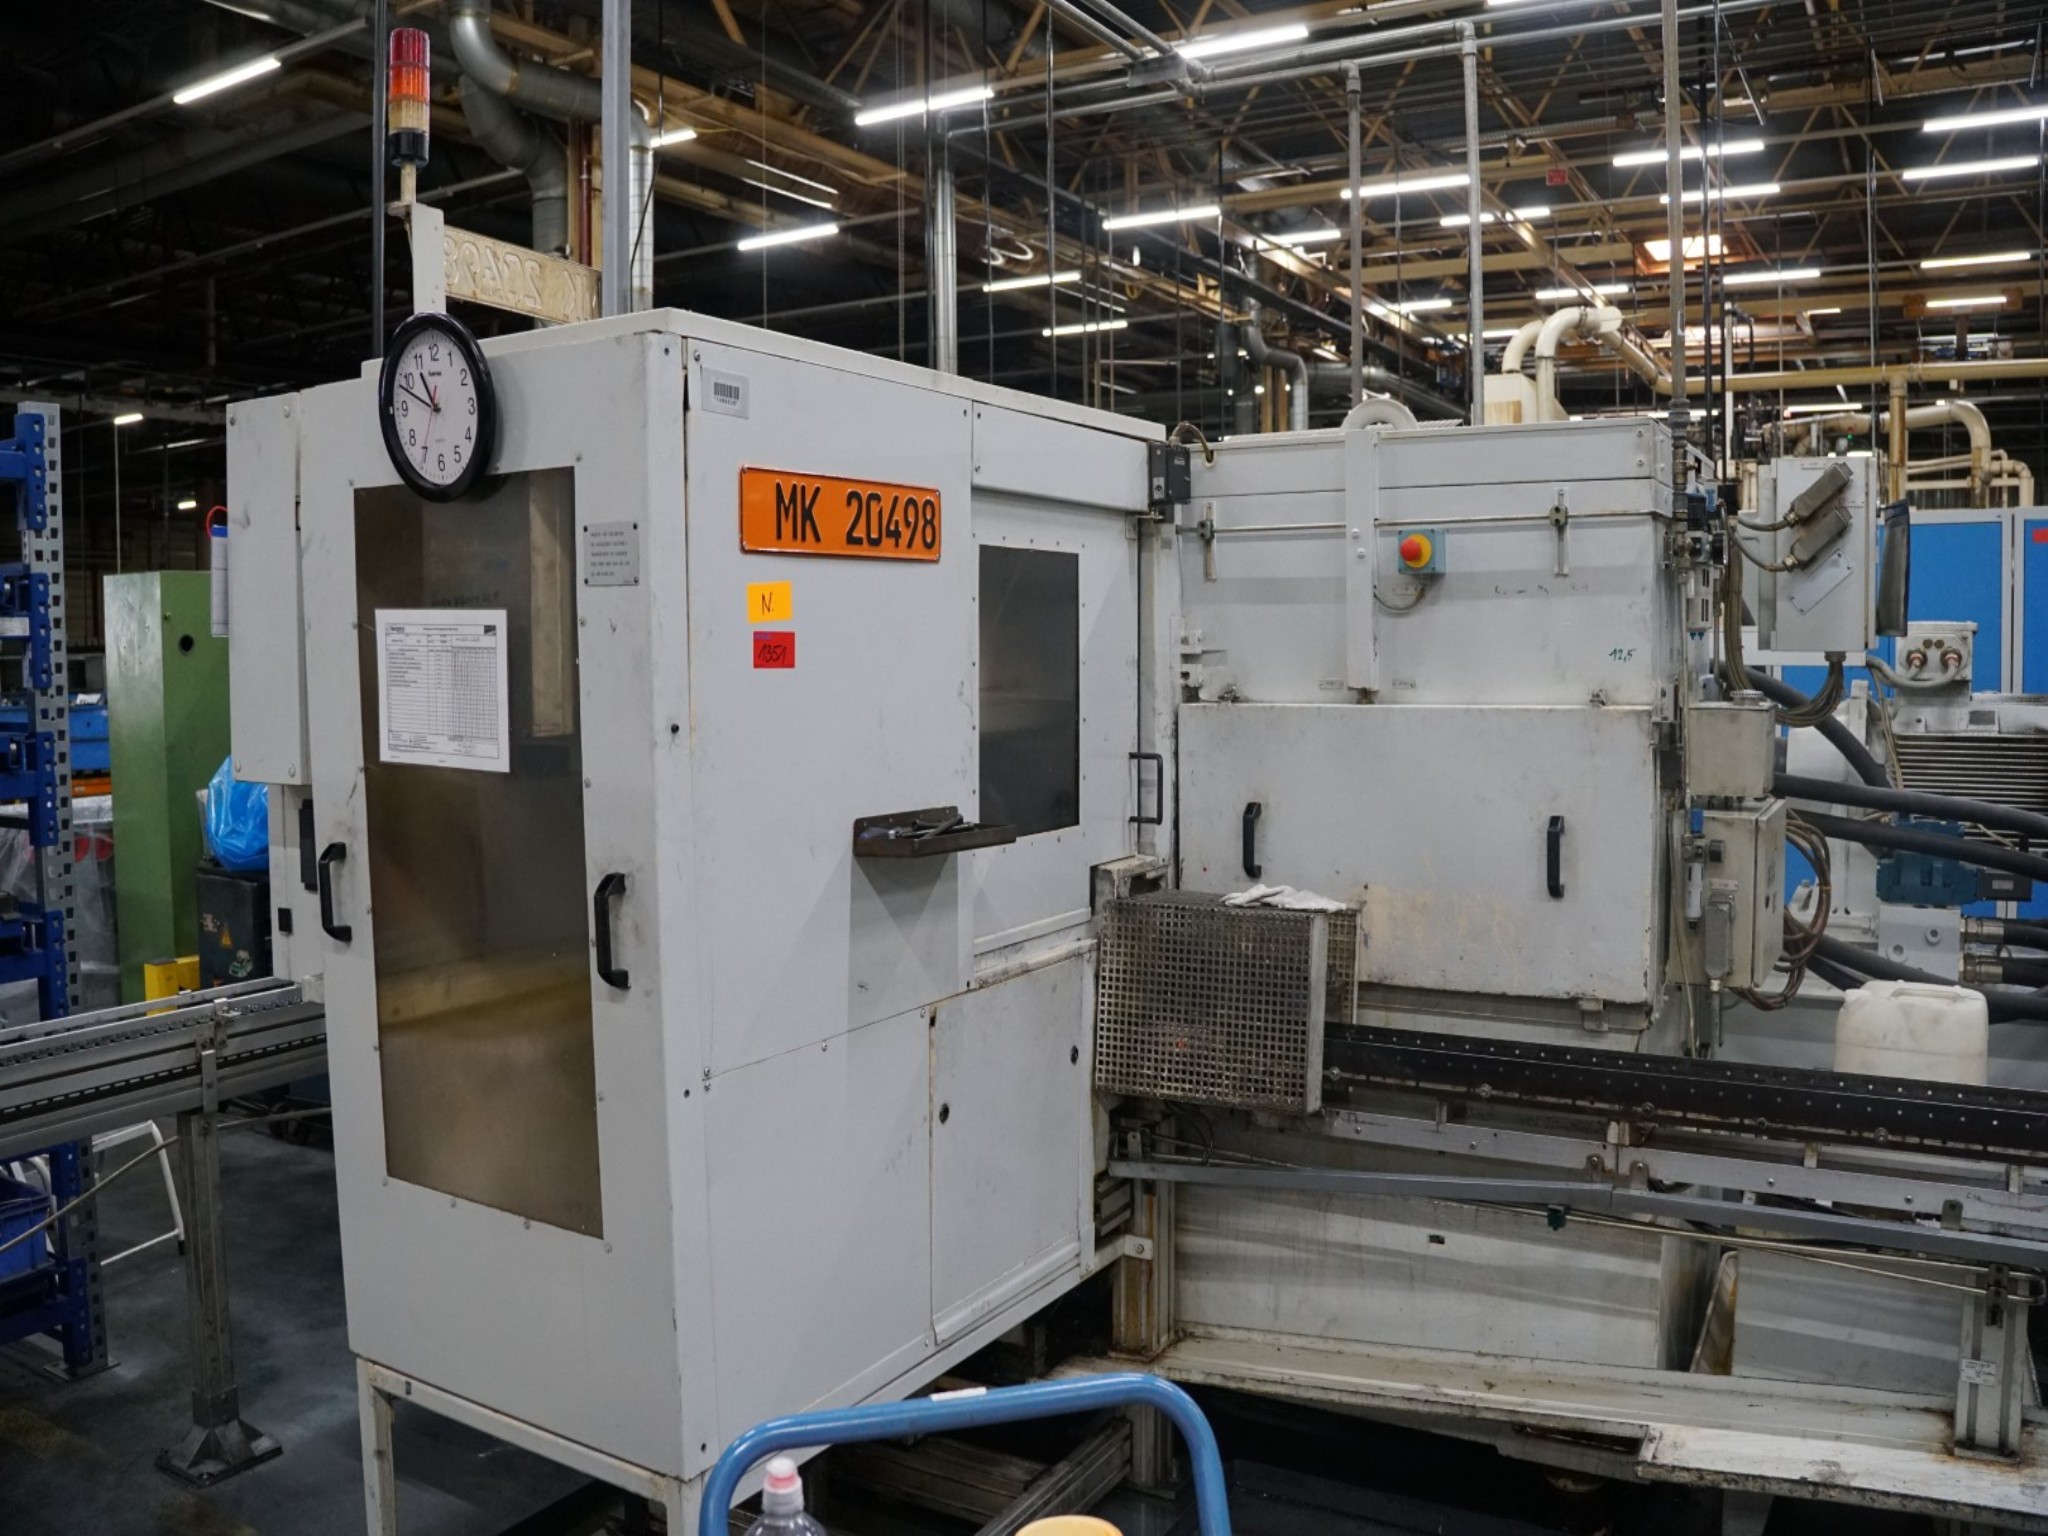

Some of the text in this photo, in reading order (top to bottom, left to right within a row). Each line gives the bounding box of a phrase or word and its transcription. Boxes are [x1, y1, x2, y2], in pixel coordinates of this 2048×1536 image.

[413, 352, 423, 370] 11
[428, 343, 440, 362] 12
[447, 350, 453, 368] 1
[403, 372, 414, 390] 10
[460, 368, 468, 387] 2
[401, 400, 409, 417] 9
[467, 397, 476, 415] 3
[408, 428, 417, 447] 8
[464, 426, 472, 443] 4
[421, 445, 428, 463] 7
[438, 453, 446, 472] 6
[453, 444, 462, 463] 5
[775, 481, 936, 549] MK 20498
